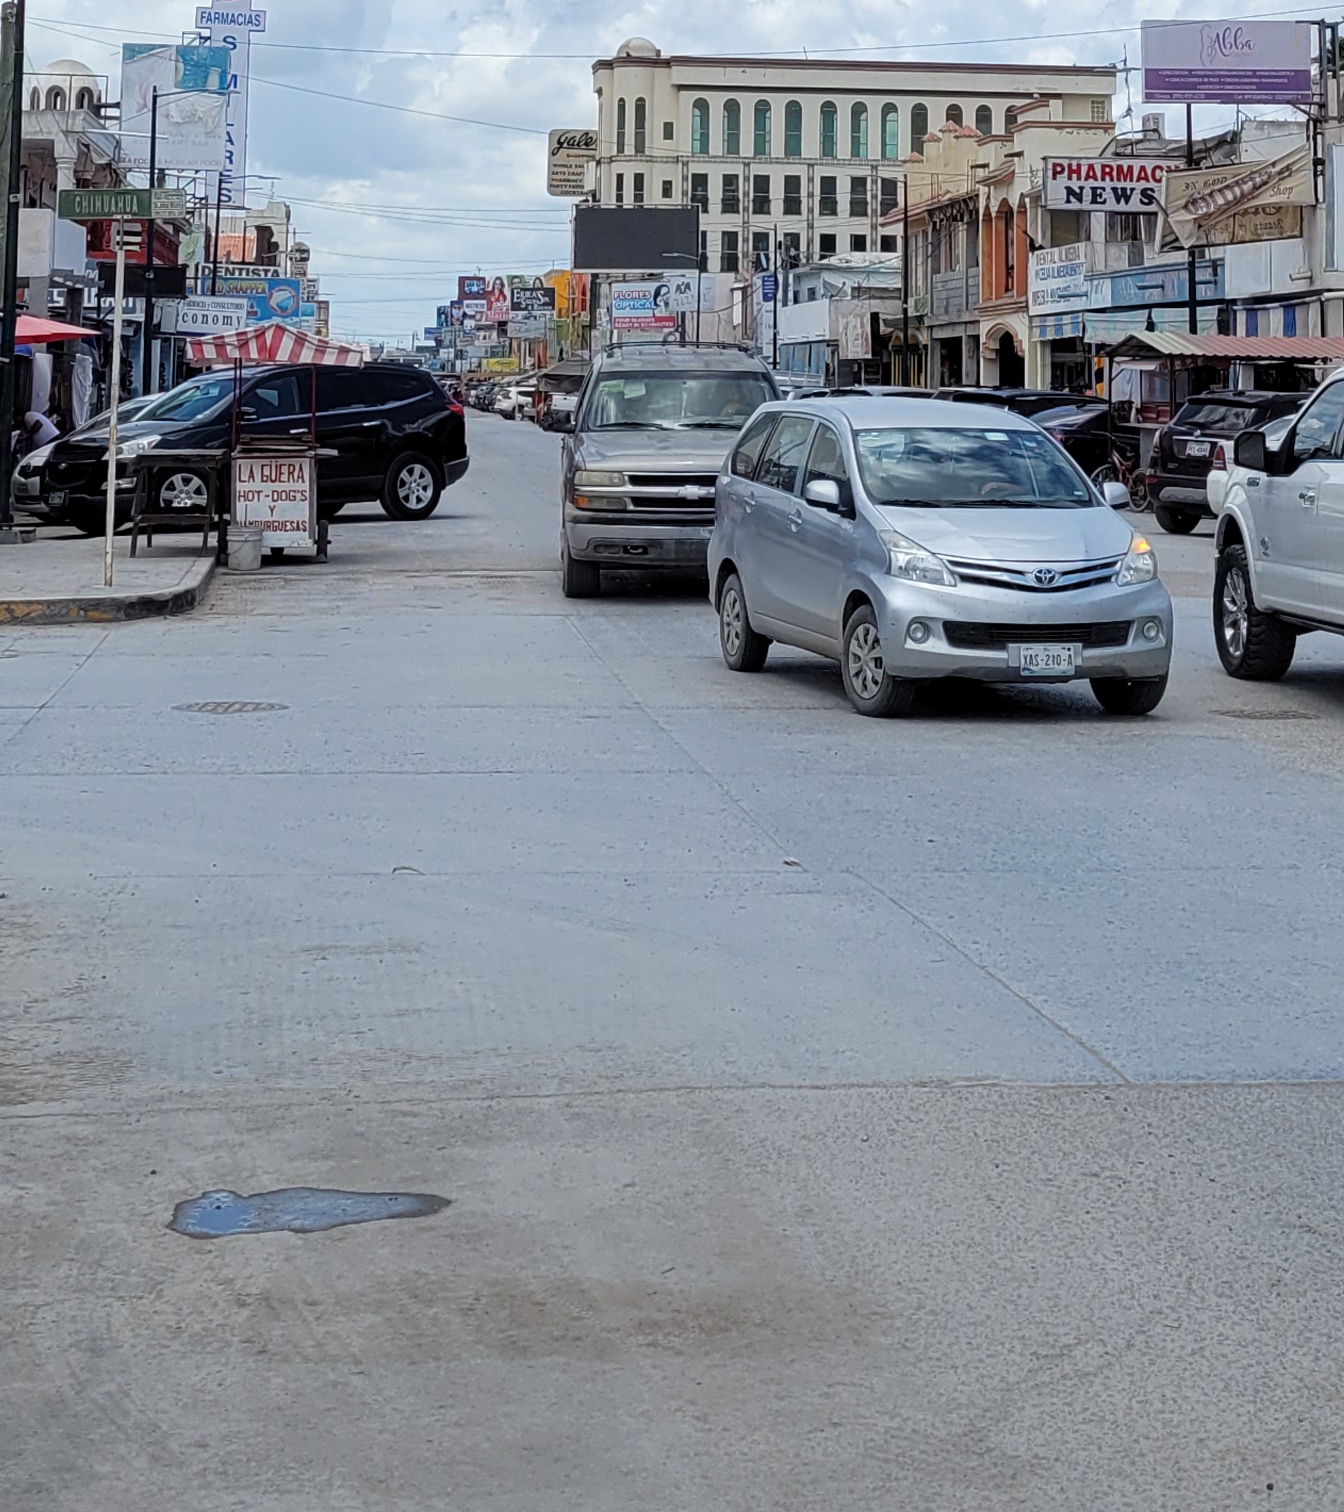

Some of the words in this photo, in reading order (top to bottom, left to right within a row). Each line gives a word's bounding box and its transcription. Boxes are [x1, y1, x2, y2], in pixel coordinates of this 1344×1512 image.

[200, 10, 261, 27] FARMACIAS
[1213, 26, 1256, 57] Abba
[74, 193, 139, 214] CHIHUAHUA
[1064, 185, 1156, 206] NEWS
[201, 265, 281, 278] DENTISTA
[613, 290, 651, 300] FLORES
[614, 300, 656, 311] OPTICAL
[181, 313, 244, 330] conomy
[238, 463, 255, 484] LA
[260, 460, 306, 484] GÜERA
[268, 504, 277, 518] Y
[1022, 653, 1073, 667] XAS-210-A
